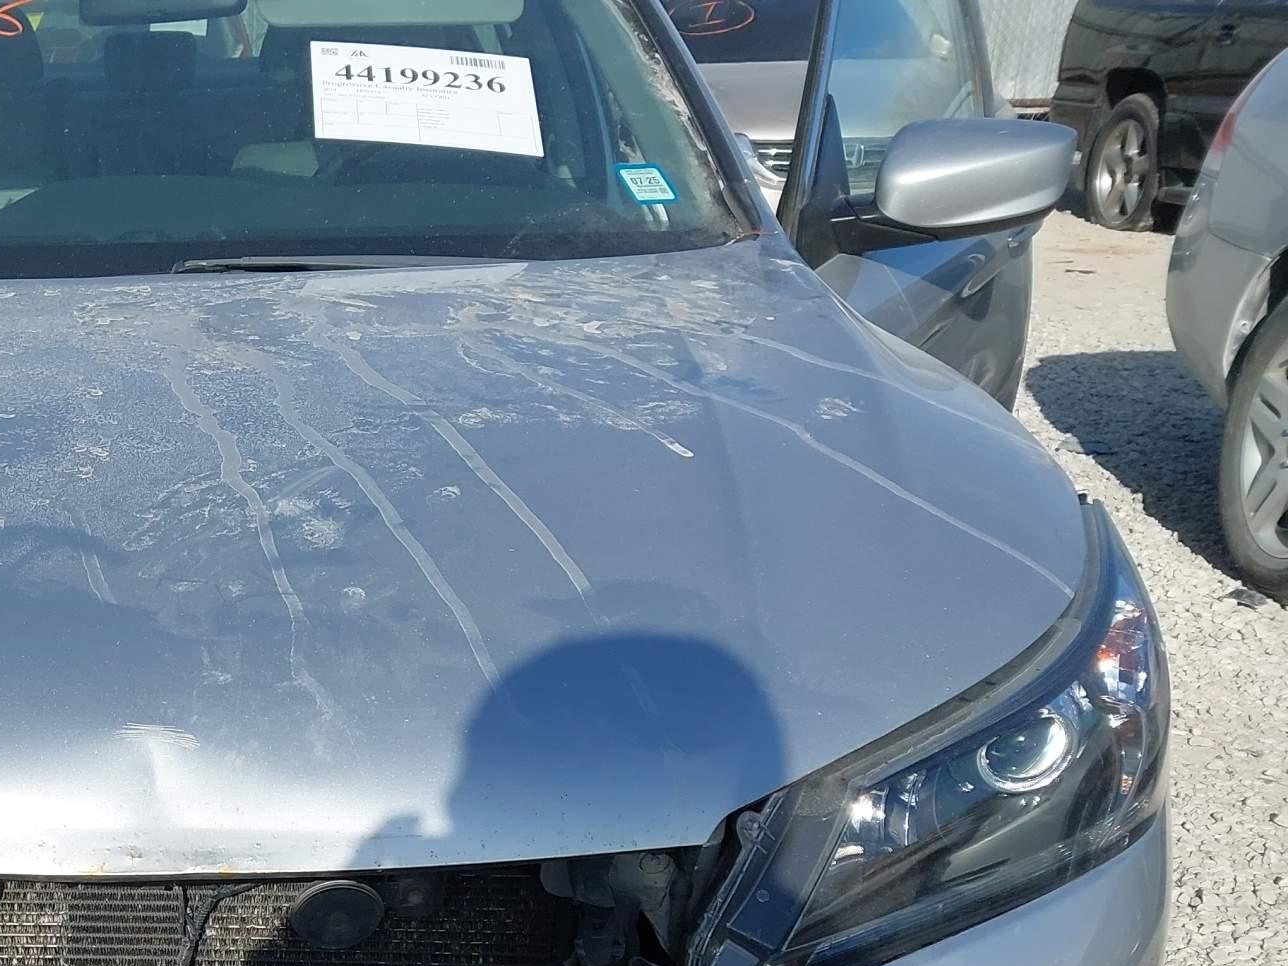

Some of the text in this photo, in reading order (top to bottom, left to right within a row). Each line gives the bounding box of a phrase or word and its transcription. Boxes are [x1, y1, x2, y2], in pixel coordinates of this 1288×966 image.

[334, 63, 506, 94] 44199236
[630, 176, 660, 185] 07 25
